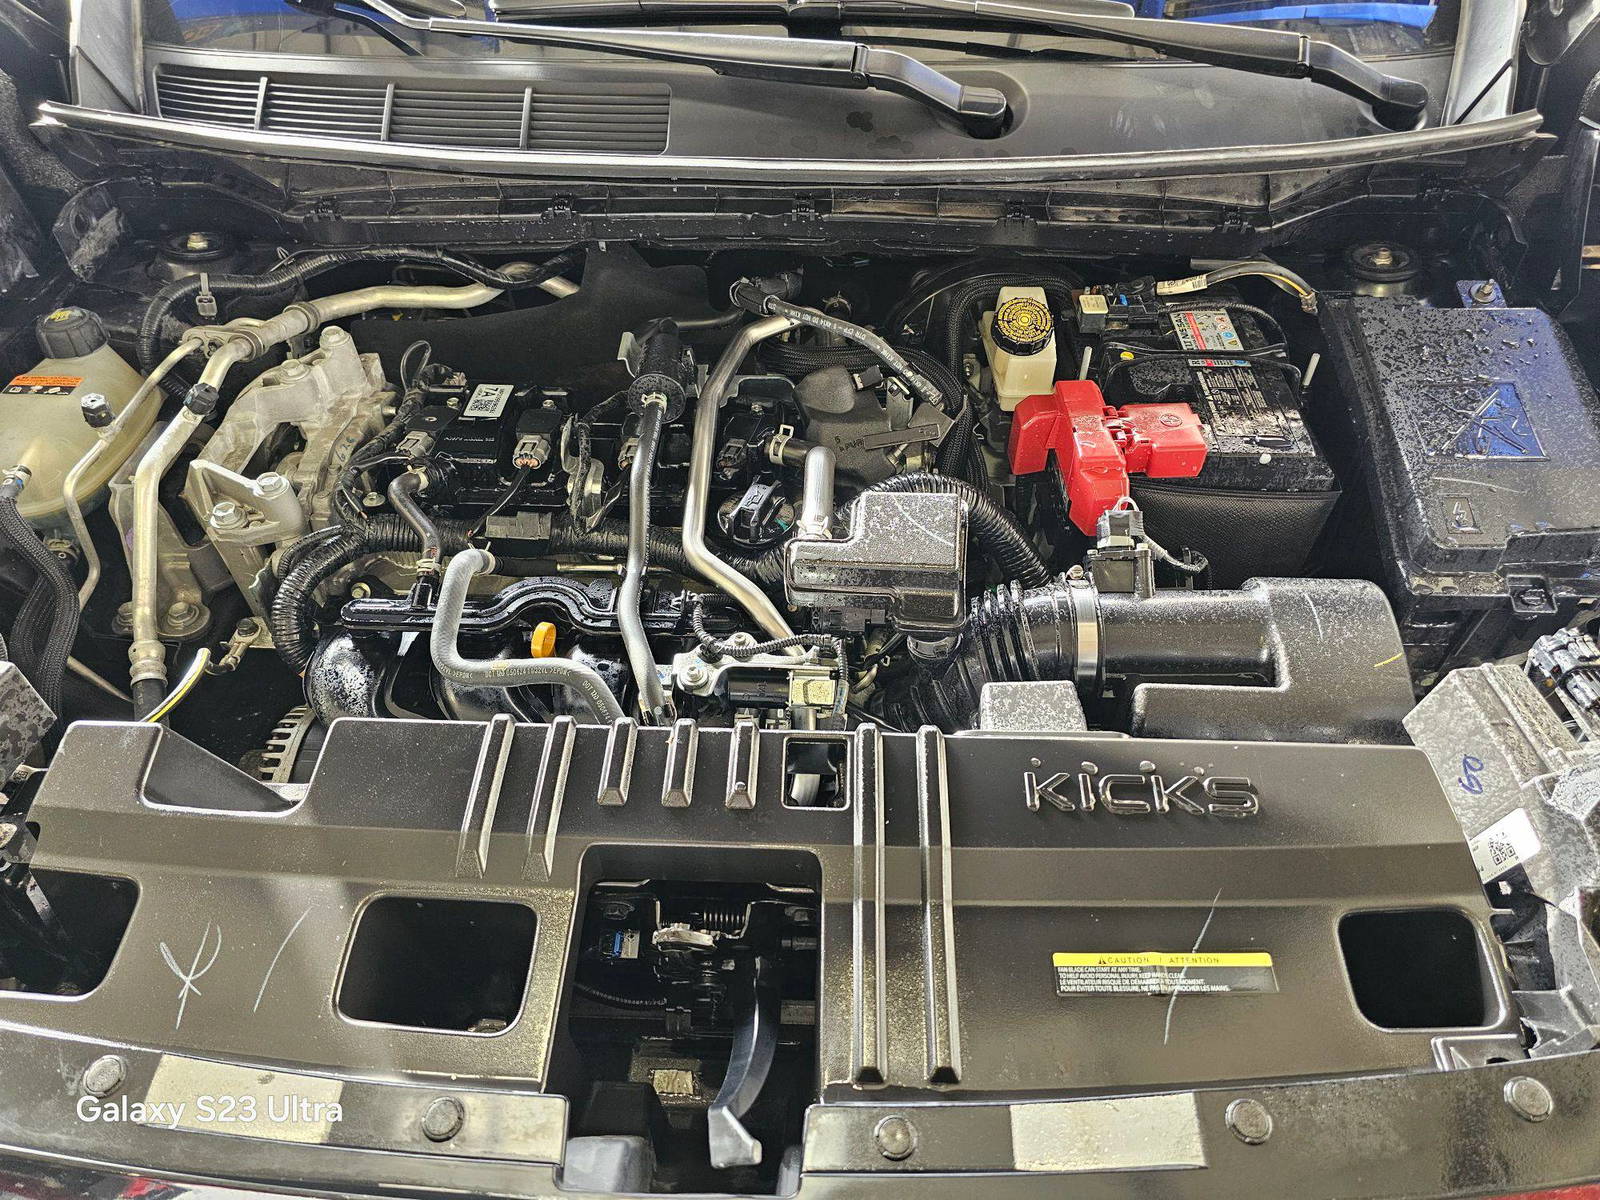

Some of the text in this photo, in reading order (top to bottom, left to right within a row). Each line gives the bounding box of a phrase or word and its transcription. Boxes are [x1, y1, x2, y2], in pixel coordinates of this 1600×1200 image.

[1024, 772, 1259, 818] KICKS
[1107, 956, 1220, 964] CAUTION ATTENTION
